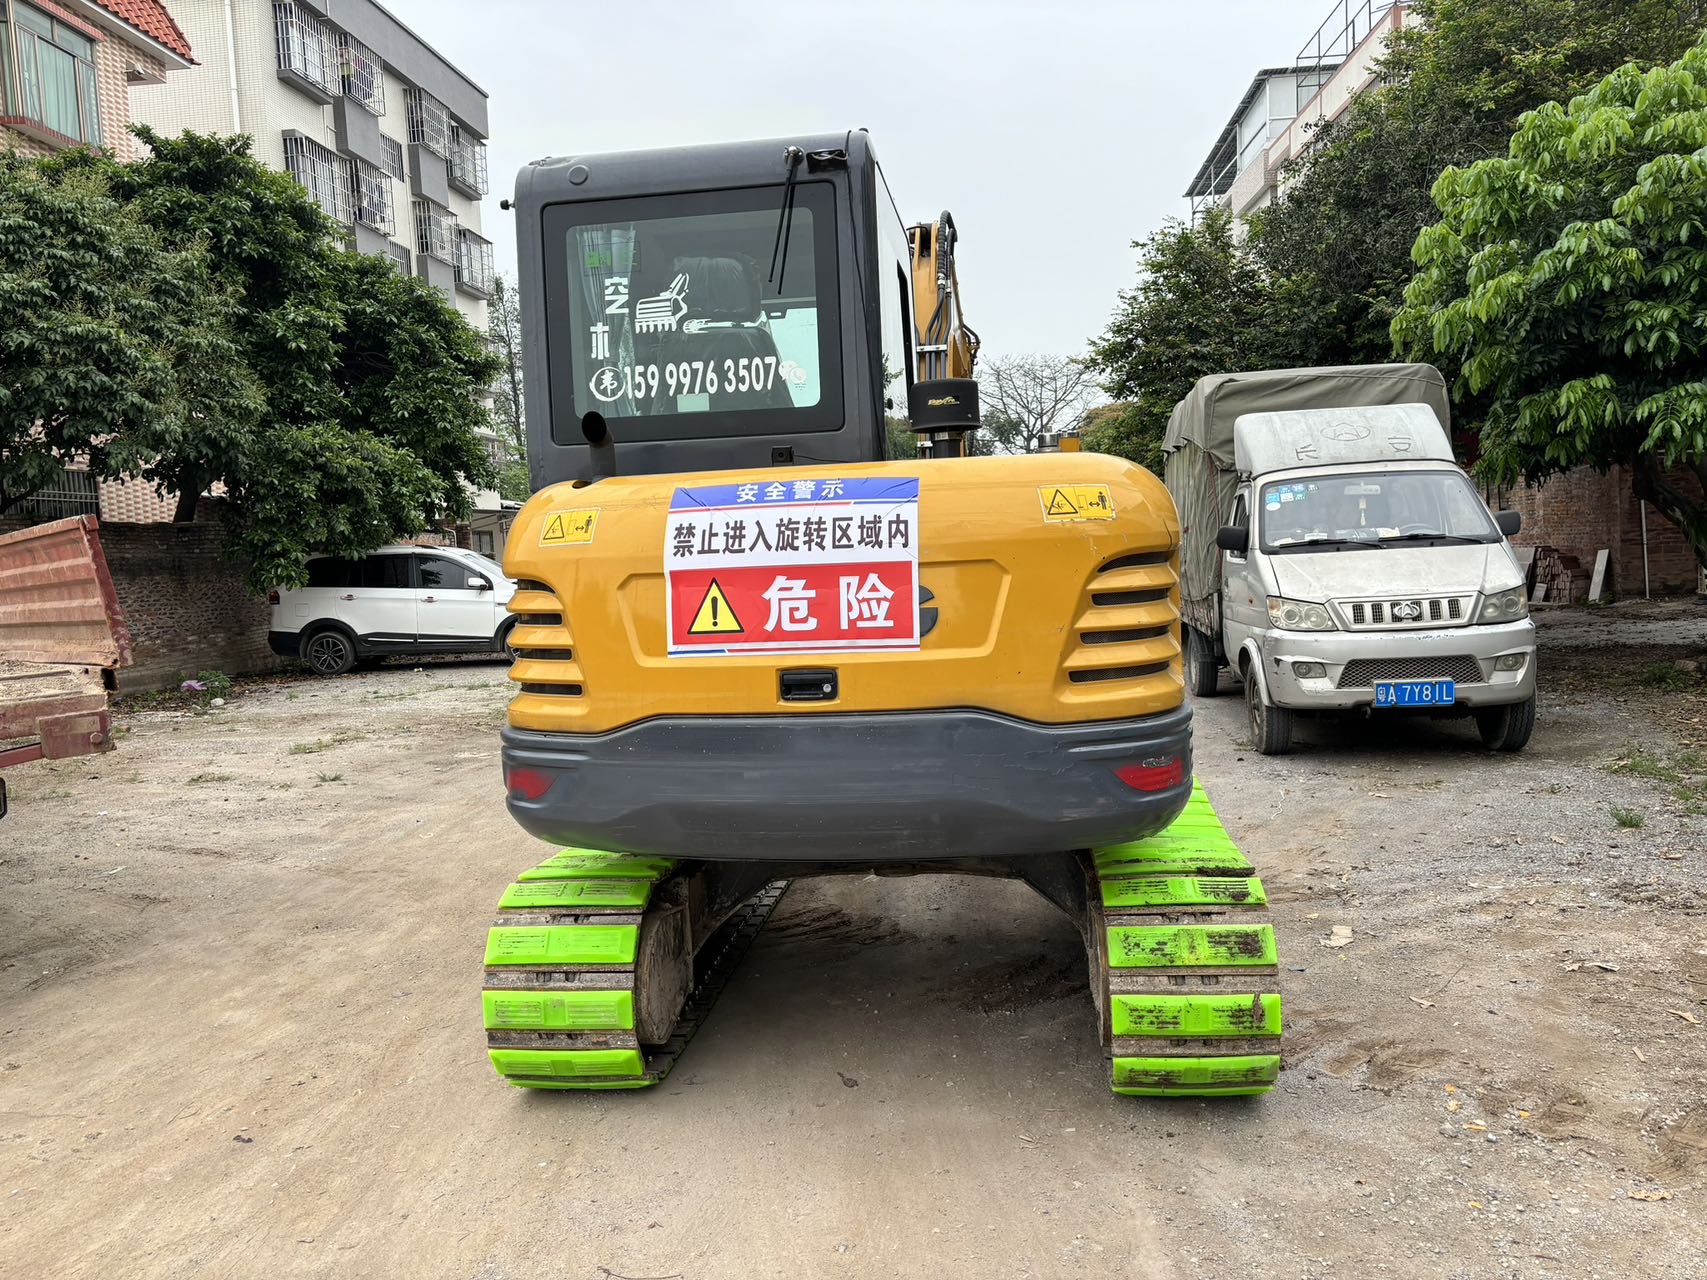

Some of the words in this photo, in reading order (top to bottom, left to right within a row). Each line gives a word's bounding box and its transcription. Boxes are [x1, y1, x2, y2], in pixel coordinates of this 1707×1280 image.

[624, 364, 660, 400] 159
[665, 359, 718, 397] 9976
[724, 355, 777, 393] 3507
[736, 479, 844, 503] 安全警示
[672, 513, 910, 558] 禁止进入旋转区域内
[761, 572, 895, 633] 危险
